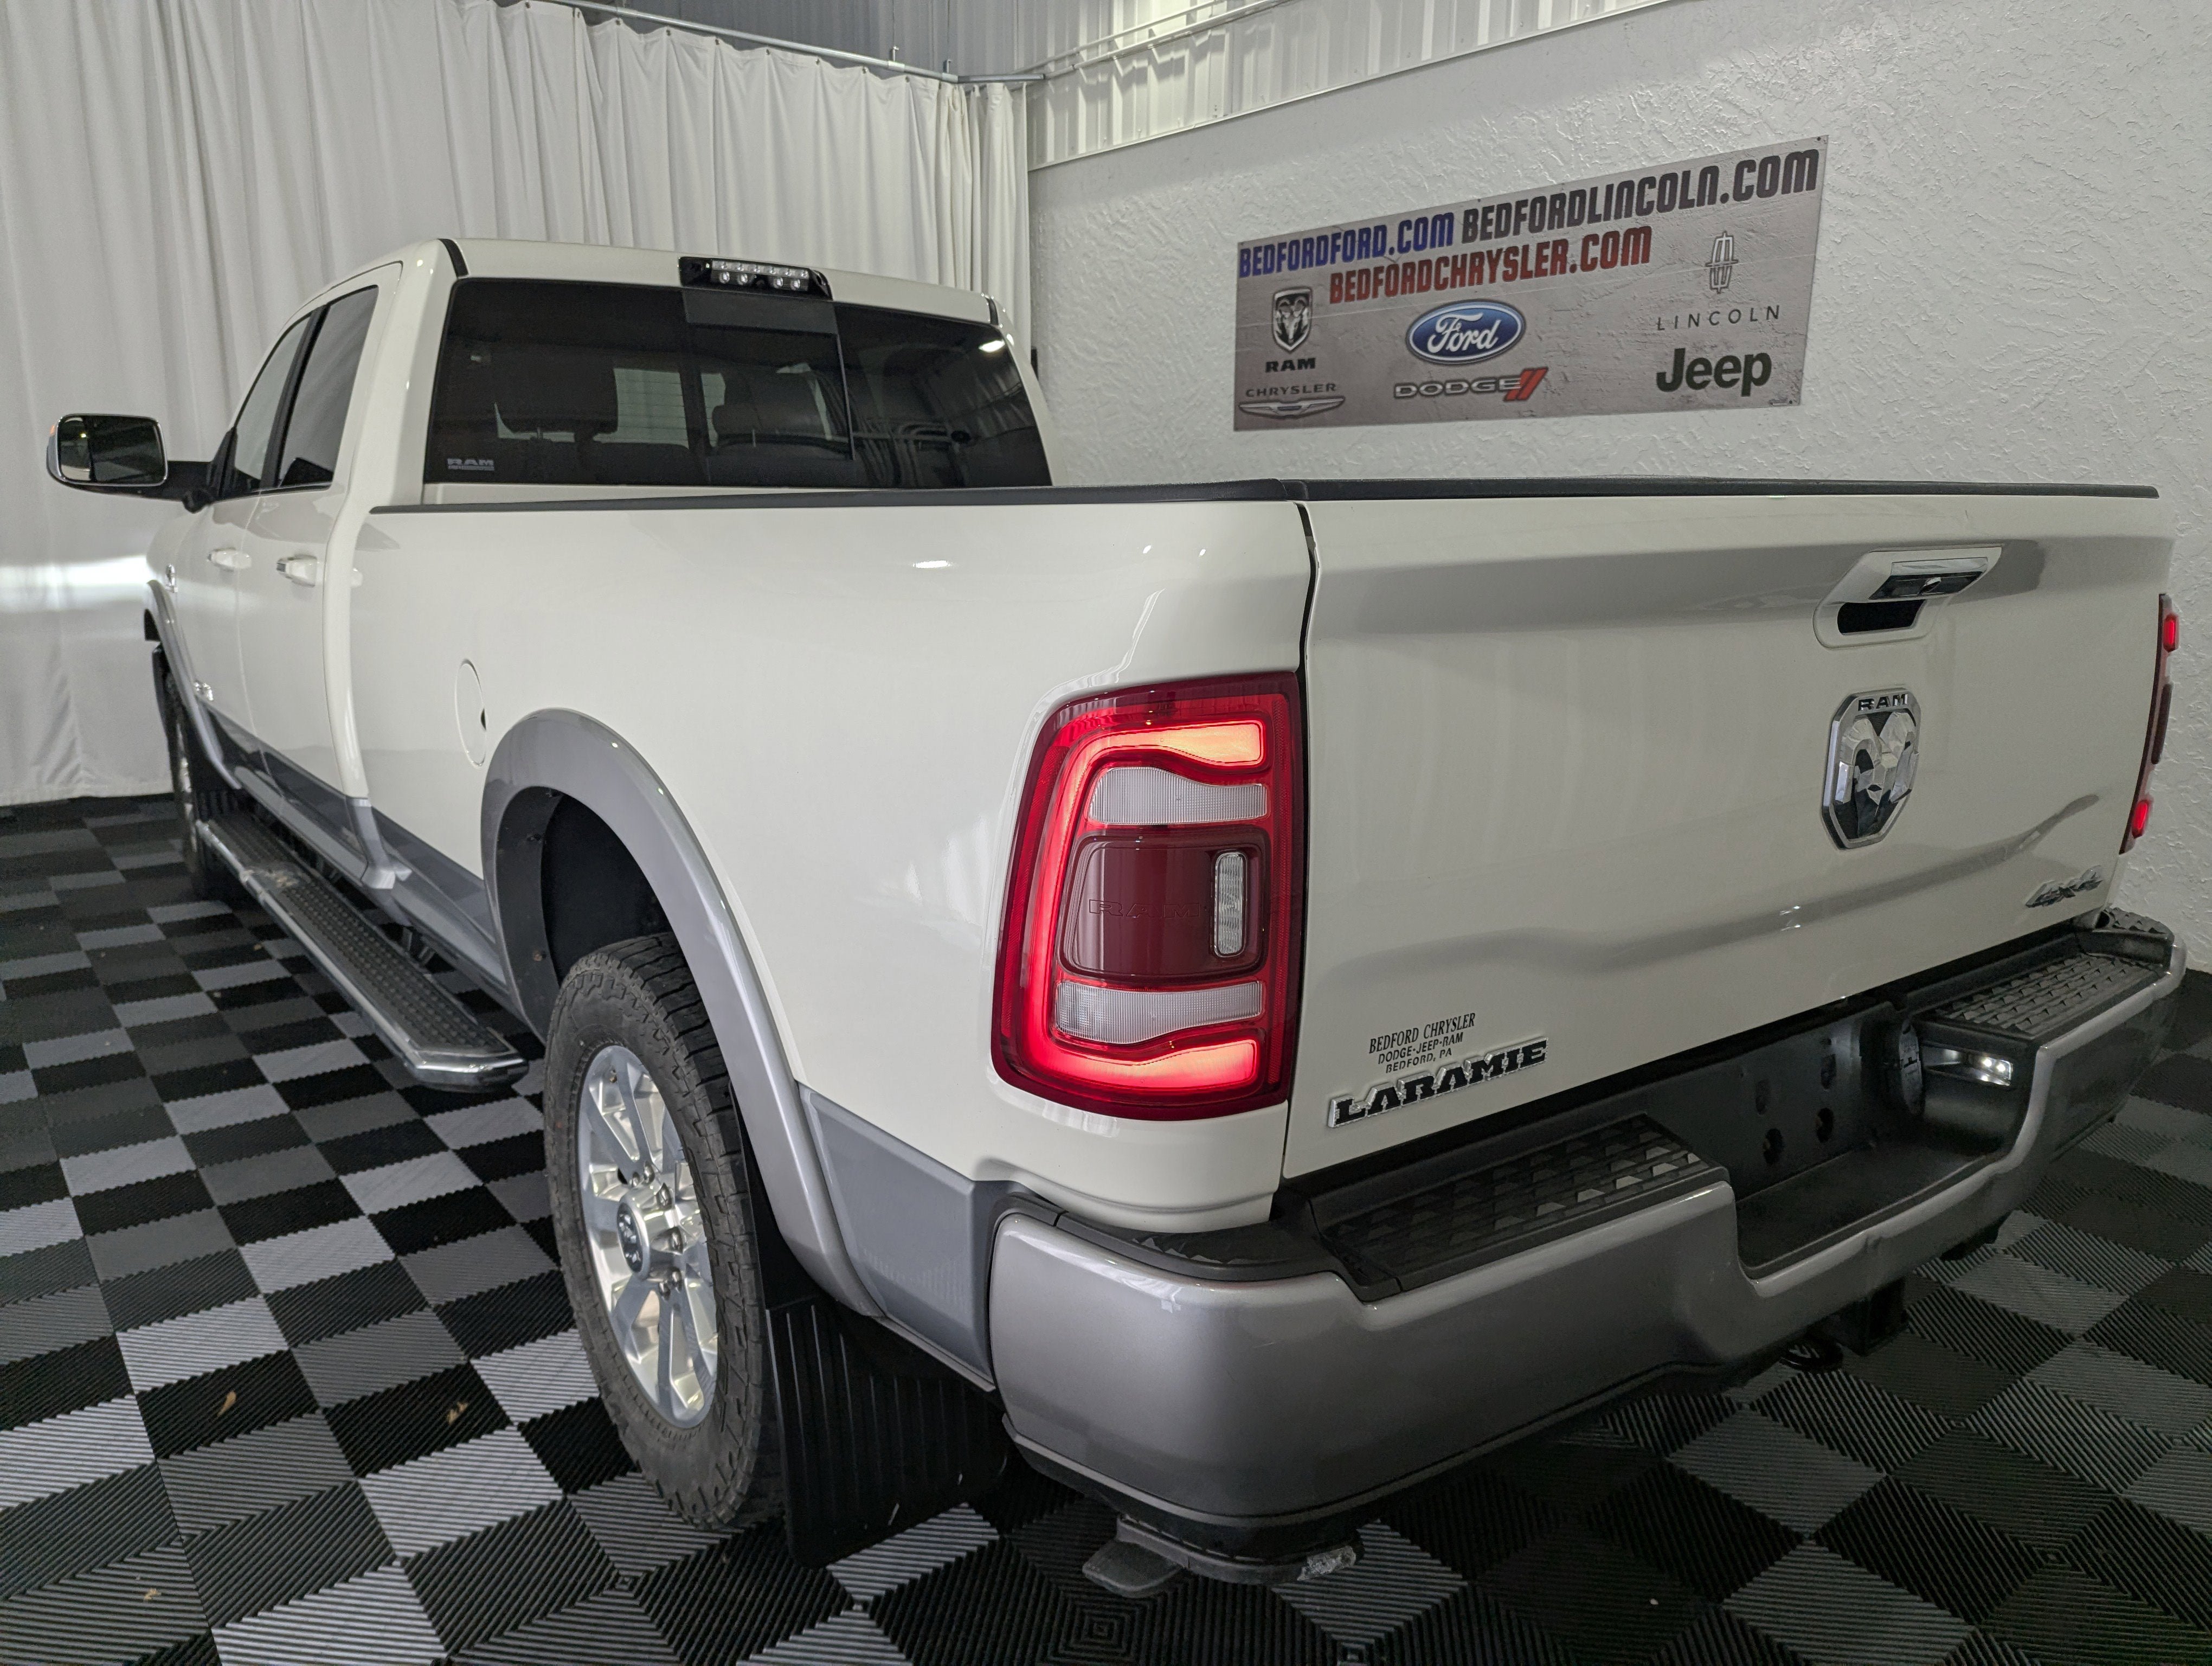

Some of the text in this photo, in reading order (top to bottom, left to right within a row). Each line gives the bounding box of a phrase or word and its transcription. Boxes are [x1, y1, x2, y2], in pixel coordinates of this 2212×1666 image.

[1239, 149, 1819, 278] BEDFORDFORD.COM BEDFORDLINCOLN.COM
[1330, 225, 1652, 304] BEDFORDCHRYSLER.COM
[1657, 305, 1780, 331] LINCOLN
[1427, 311, 1502, 353] Ford
[1265, 357, 1316, 373] RAM
[1656, 348, 1772, 397] Jeep
[1246, 383, 1337, 398] CHRYSLER
[1394, 375, 1522, 399] DODGE
[1858, 694, 1908, 712] RAM
[1089, 899, 1200, 918] RAM
[1368, 1012, 1476, 1054] BEDFORD CHRYSLER
[1385, 1047, 1452, 1074] BEDFORD, PA
[1328, 1036, 1548, 1128] LARAMIE
